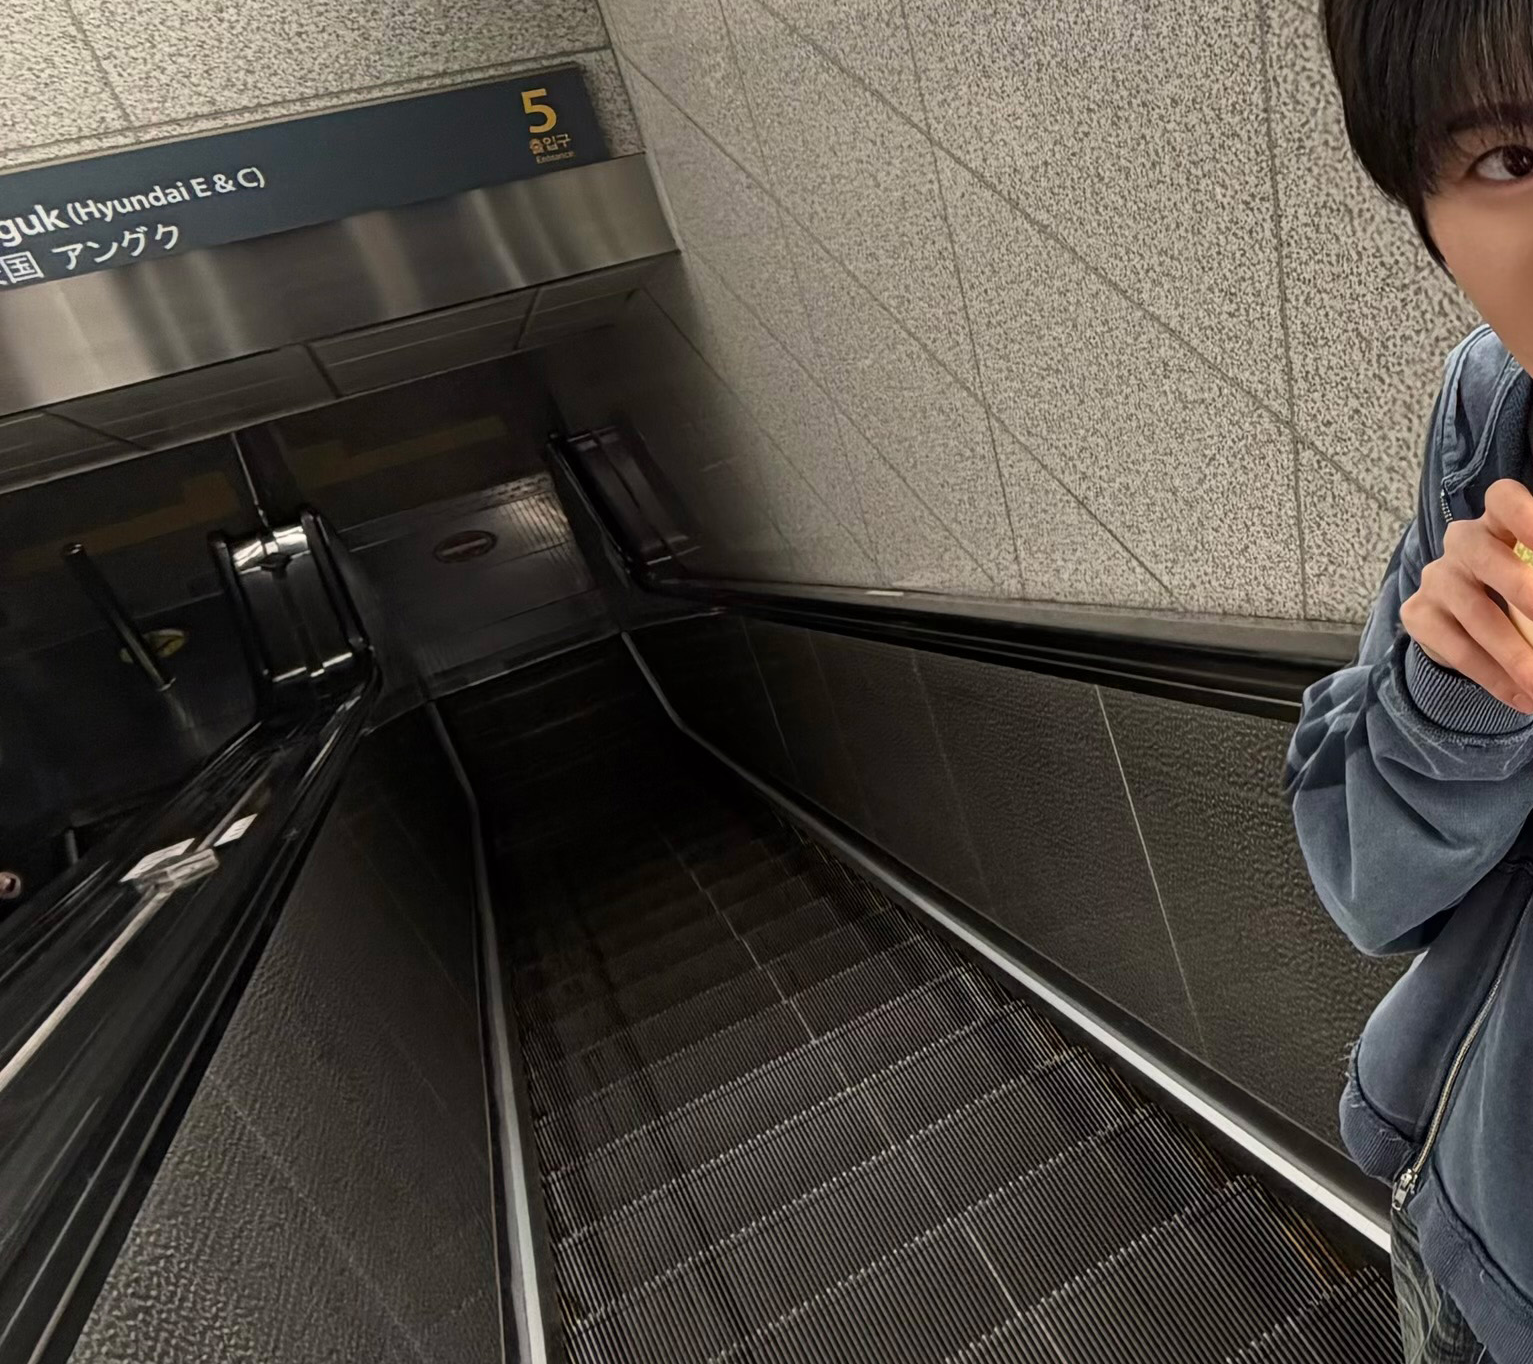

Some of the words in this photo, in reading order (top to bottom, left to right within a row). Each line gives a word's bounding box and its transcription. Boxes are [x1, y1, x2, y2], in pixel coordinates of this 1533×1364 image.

[521, 88, 557, 133] 5
[529, 133, 572, 155] 출입구
[66, 181, 190, 226] (Hyundai
[190, 177, 212, 199] E
[212, 173, 236, 194] &
[237, 166, 265, 189] C)
[0, 250, 45, 288] 国
[51, 223, 180, 271] アングク
